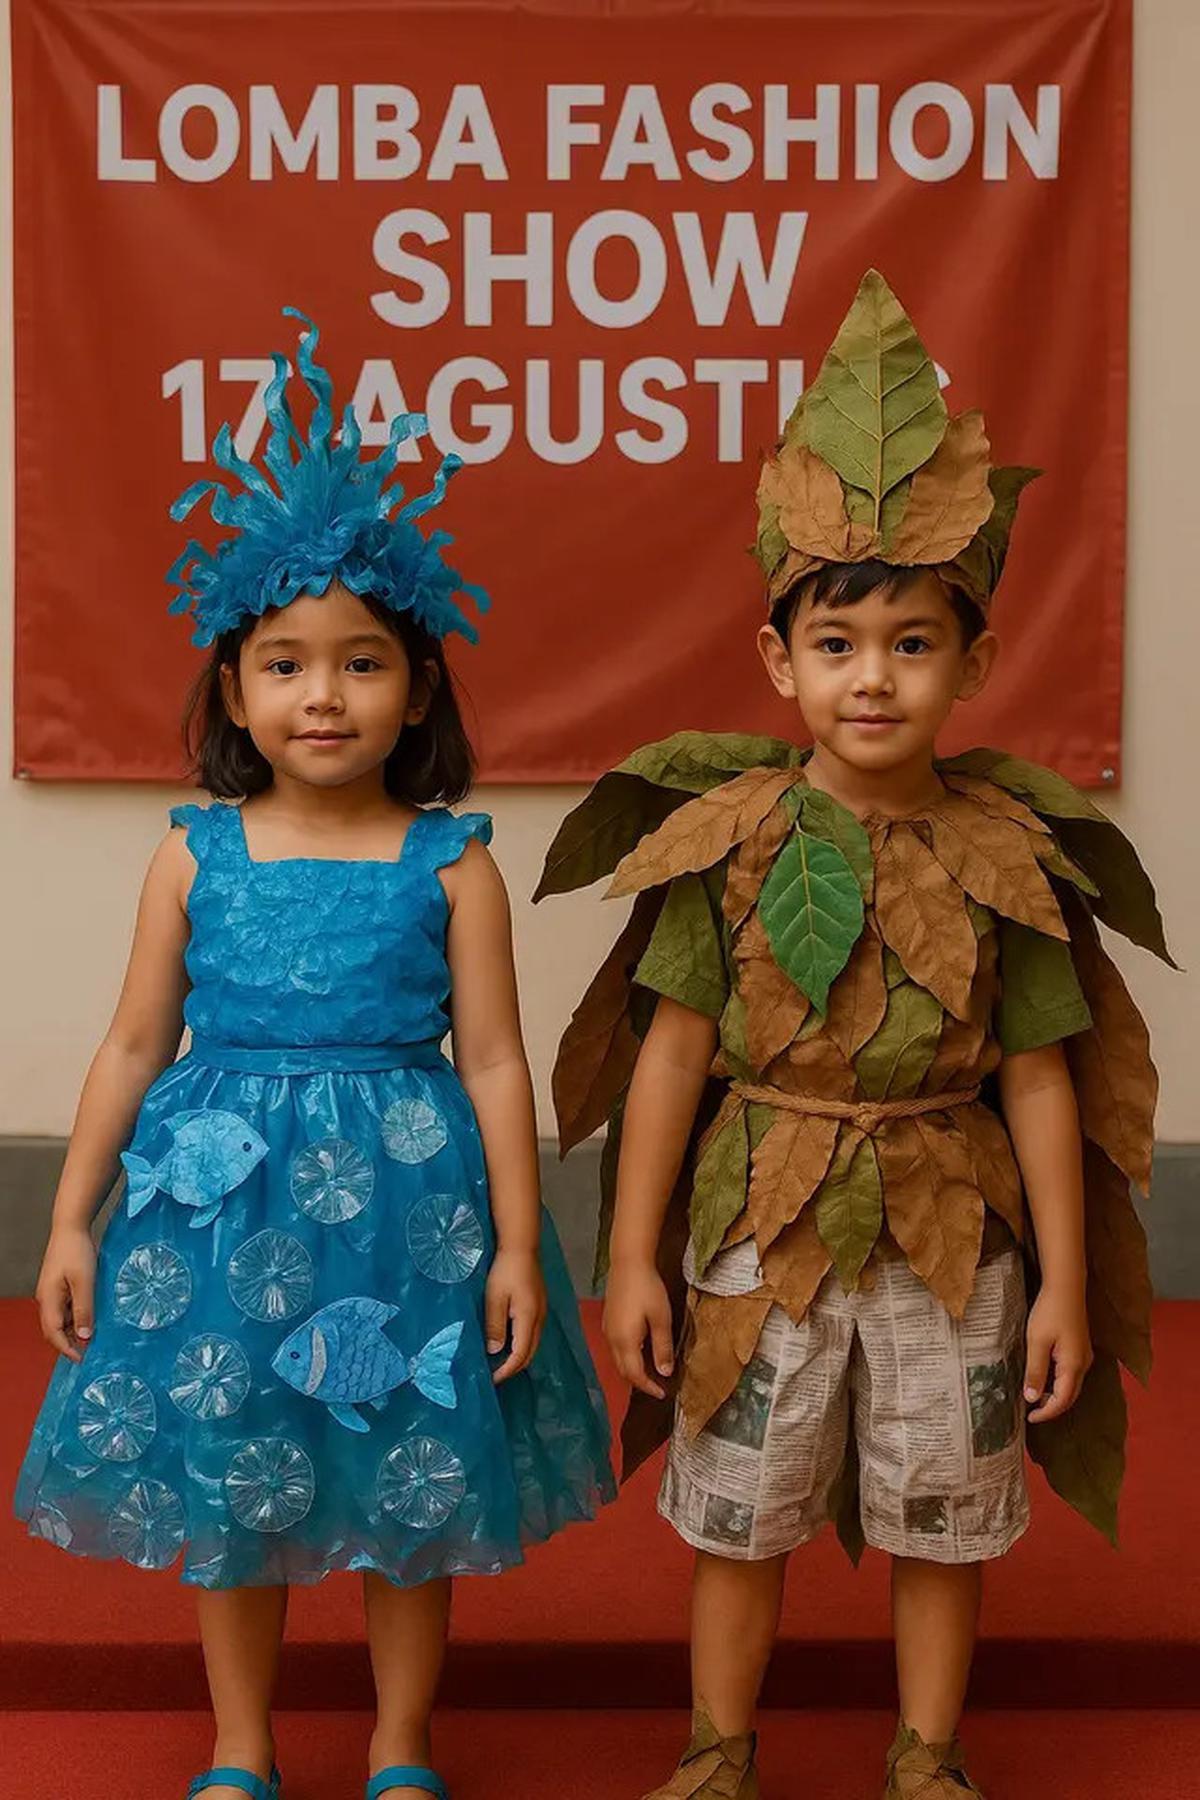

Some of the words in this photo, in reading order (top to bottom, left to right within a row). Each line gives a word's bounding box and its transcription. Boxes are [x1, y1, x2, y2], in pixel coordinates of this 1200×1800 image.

[97, 84, 508, 182] LOMBA
[547, 82, 1060, 182] FASHION
[371, 209, 808, 329] SHOW
[161, 359, 294, 463] 17
[334, 356, 952, 464] AGUSTI
